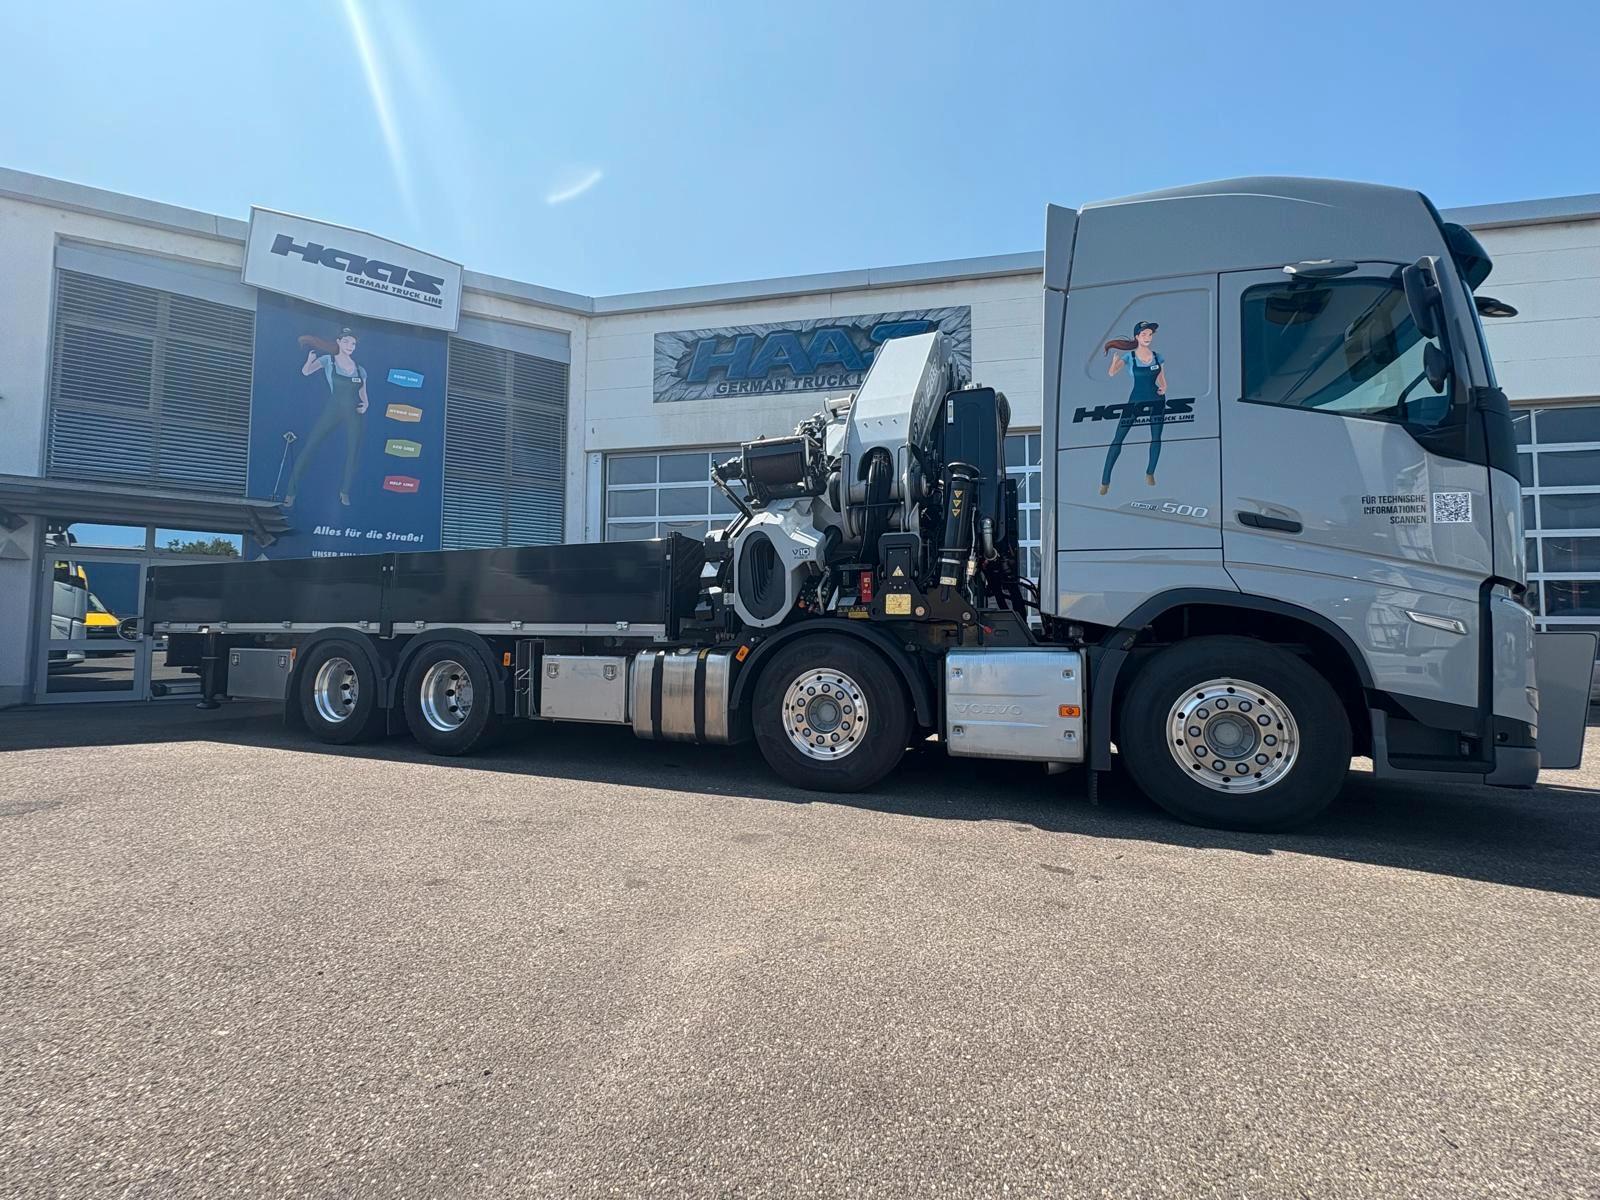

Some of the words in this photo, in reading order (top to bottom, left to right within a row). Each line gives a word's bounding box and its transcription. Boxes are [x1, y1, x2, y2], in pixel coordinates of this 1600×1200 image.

[346, 275, 389, 291] GERMAN
[391, 286, 421, 299] TRUCK
[423, 295, 443, 305] LINE
[716, 378, 786, 394] GERMAN
[792, 373, 850, 389] TRUCK
[1361, 494, 1377, 505] FÜR
[1378, 494, 1426, 504] TECHNISCHE
[1161, 502, 1209, 518] 500
[1363, 504, 1427, 515] INFORMATIONEN
[1389, 515, 1427, 525] SCANNEN
[313, 525, 342, 537] Alles
[345, 527, 362, 538] für
[366, 530, 383, 539] die
[385, 531, 424, 542] Straße!
[953, 702, 1023, 717] VOLVO
